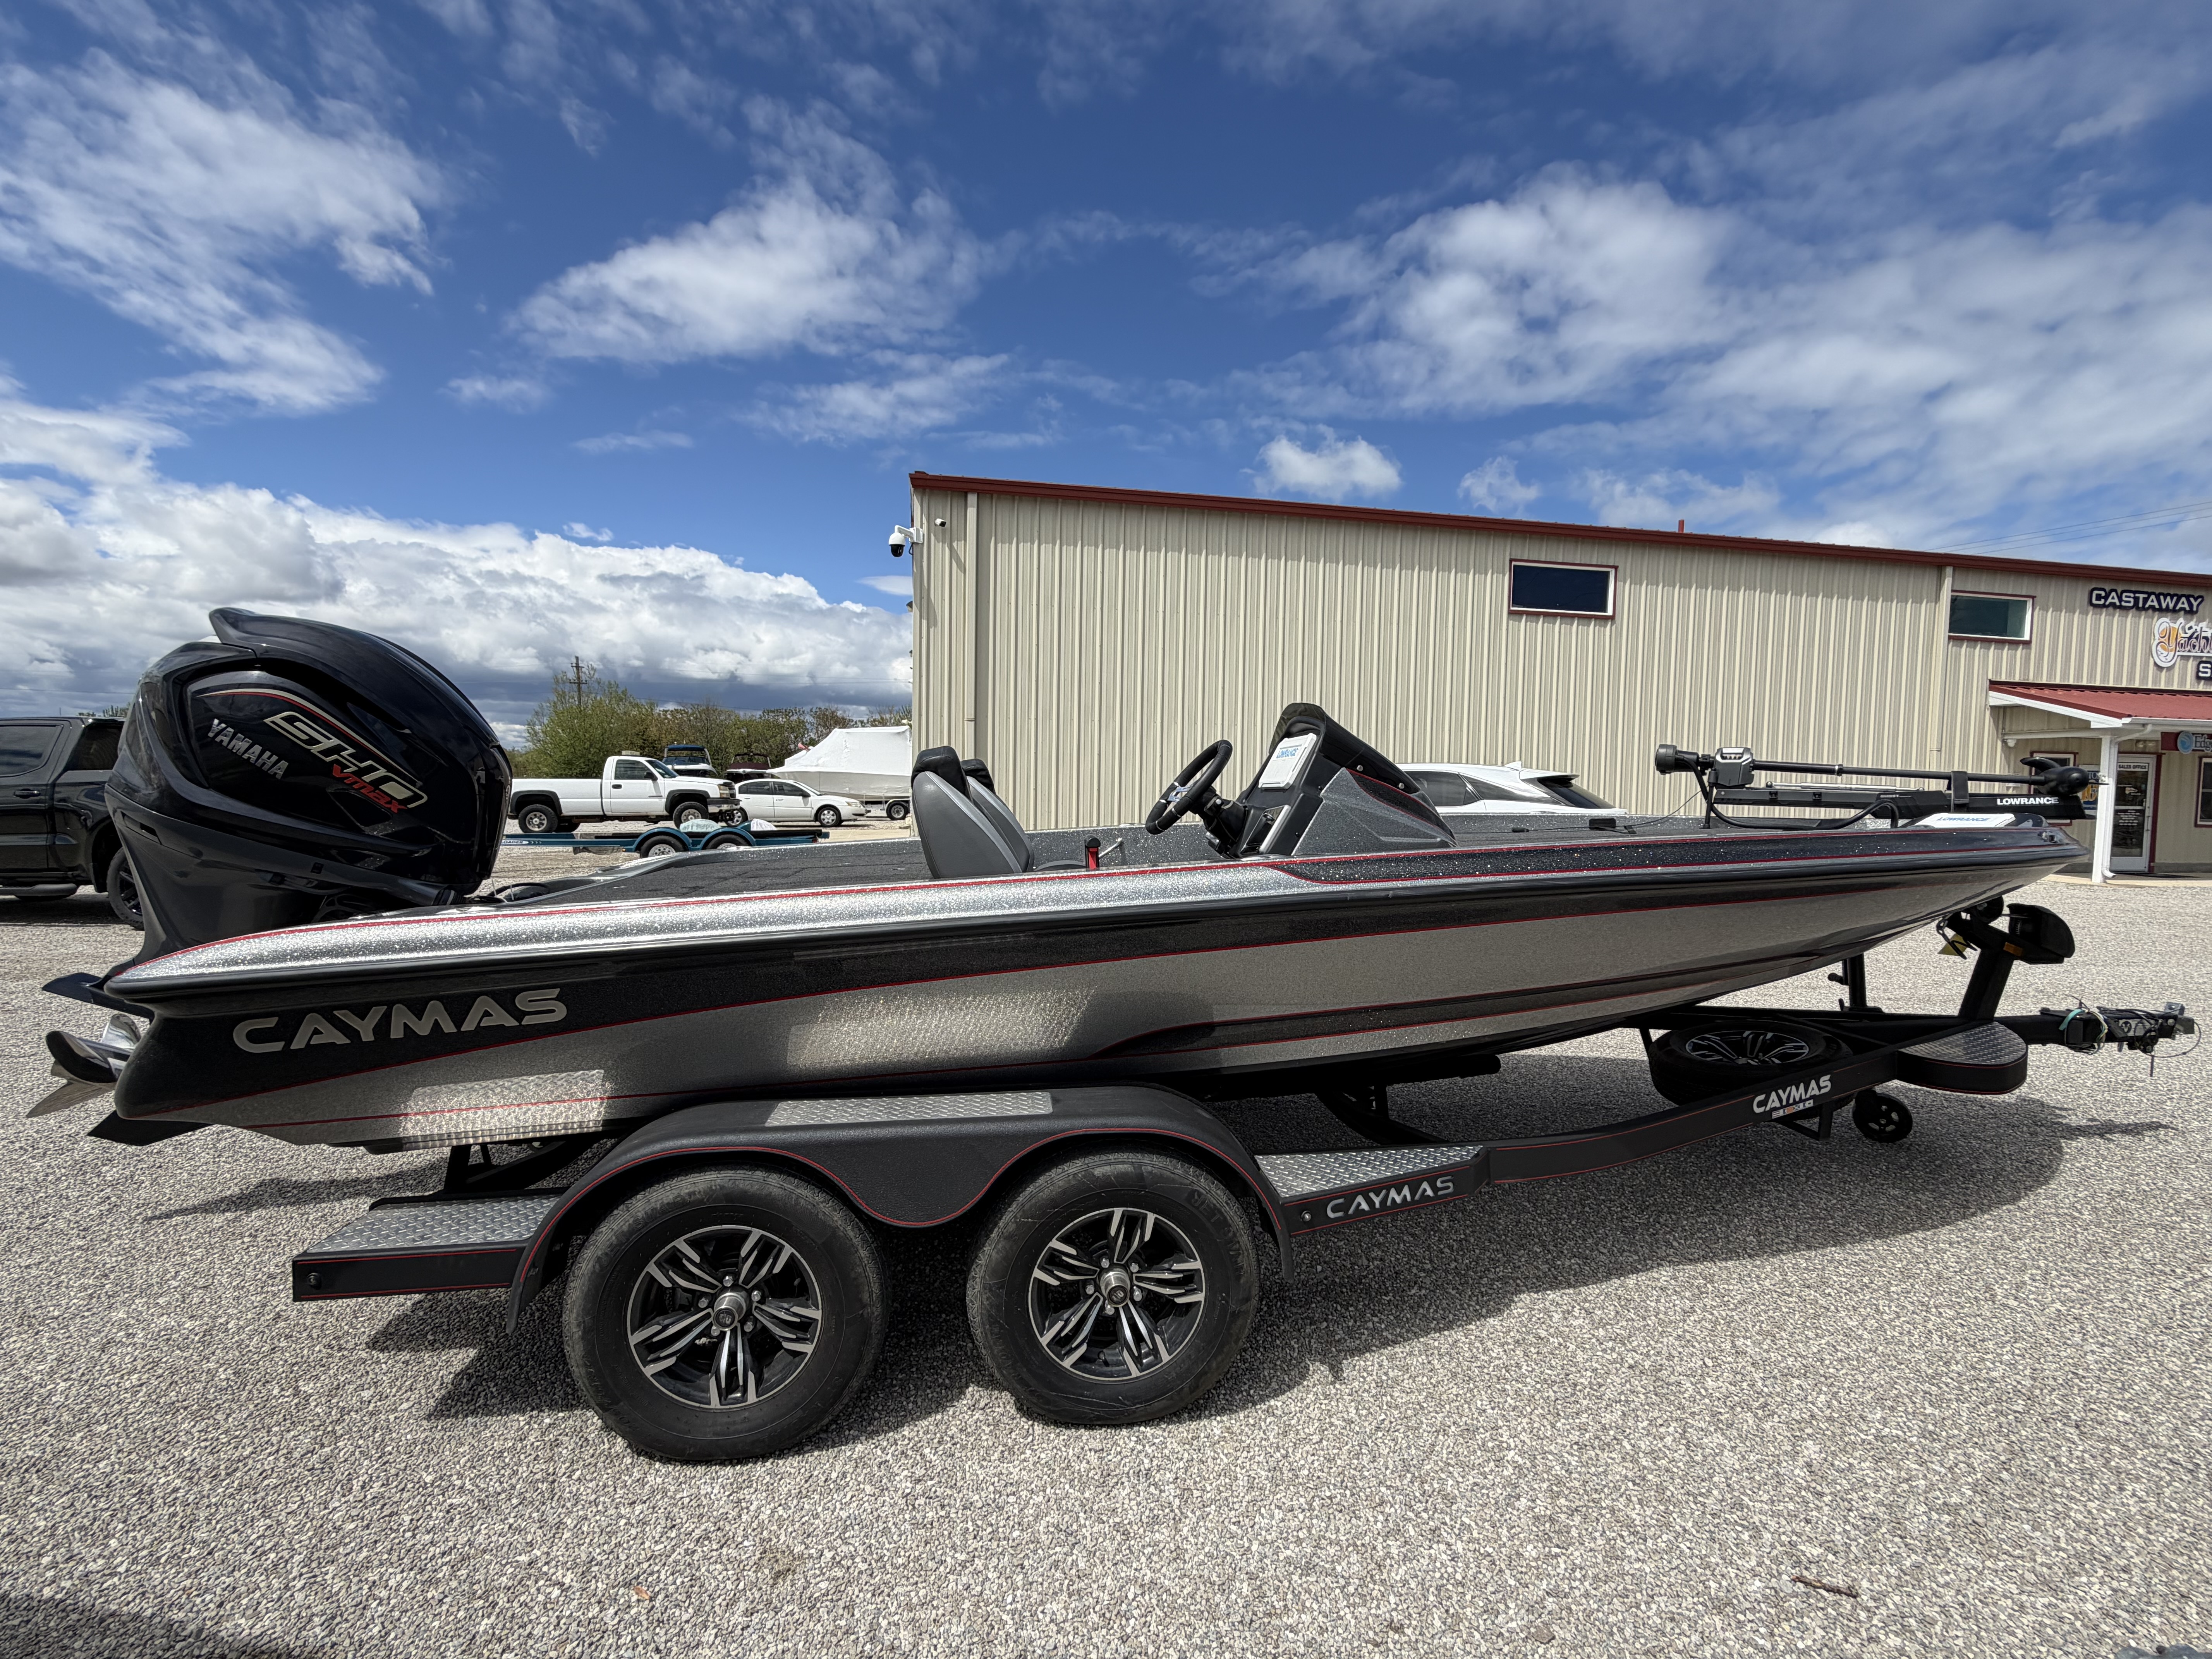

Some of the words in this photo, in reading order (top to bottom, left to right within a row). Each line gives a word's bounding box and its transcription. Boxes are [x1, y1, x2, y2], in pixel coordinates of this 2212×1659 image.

[2092, 590, 2202, 611] CASTAWAY
[2198, 663, 2212, 677] S
[208, 718, 289, 780] YAMAHA
[263, 711, 428, 809] SHO
[2195, 735, 2212, 751] Edg
[1997, 797, 2059, 805] LOWRANCE
[233, 988, 567, 1053] CAYMAS
[1753, 1074, 1831, 1113] CAYMAS
[1327, 1176, 1454, 1218] CAYMAS
